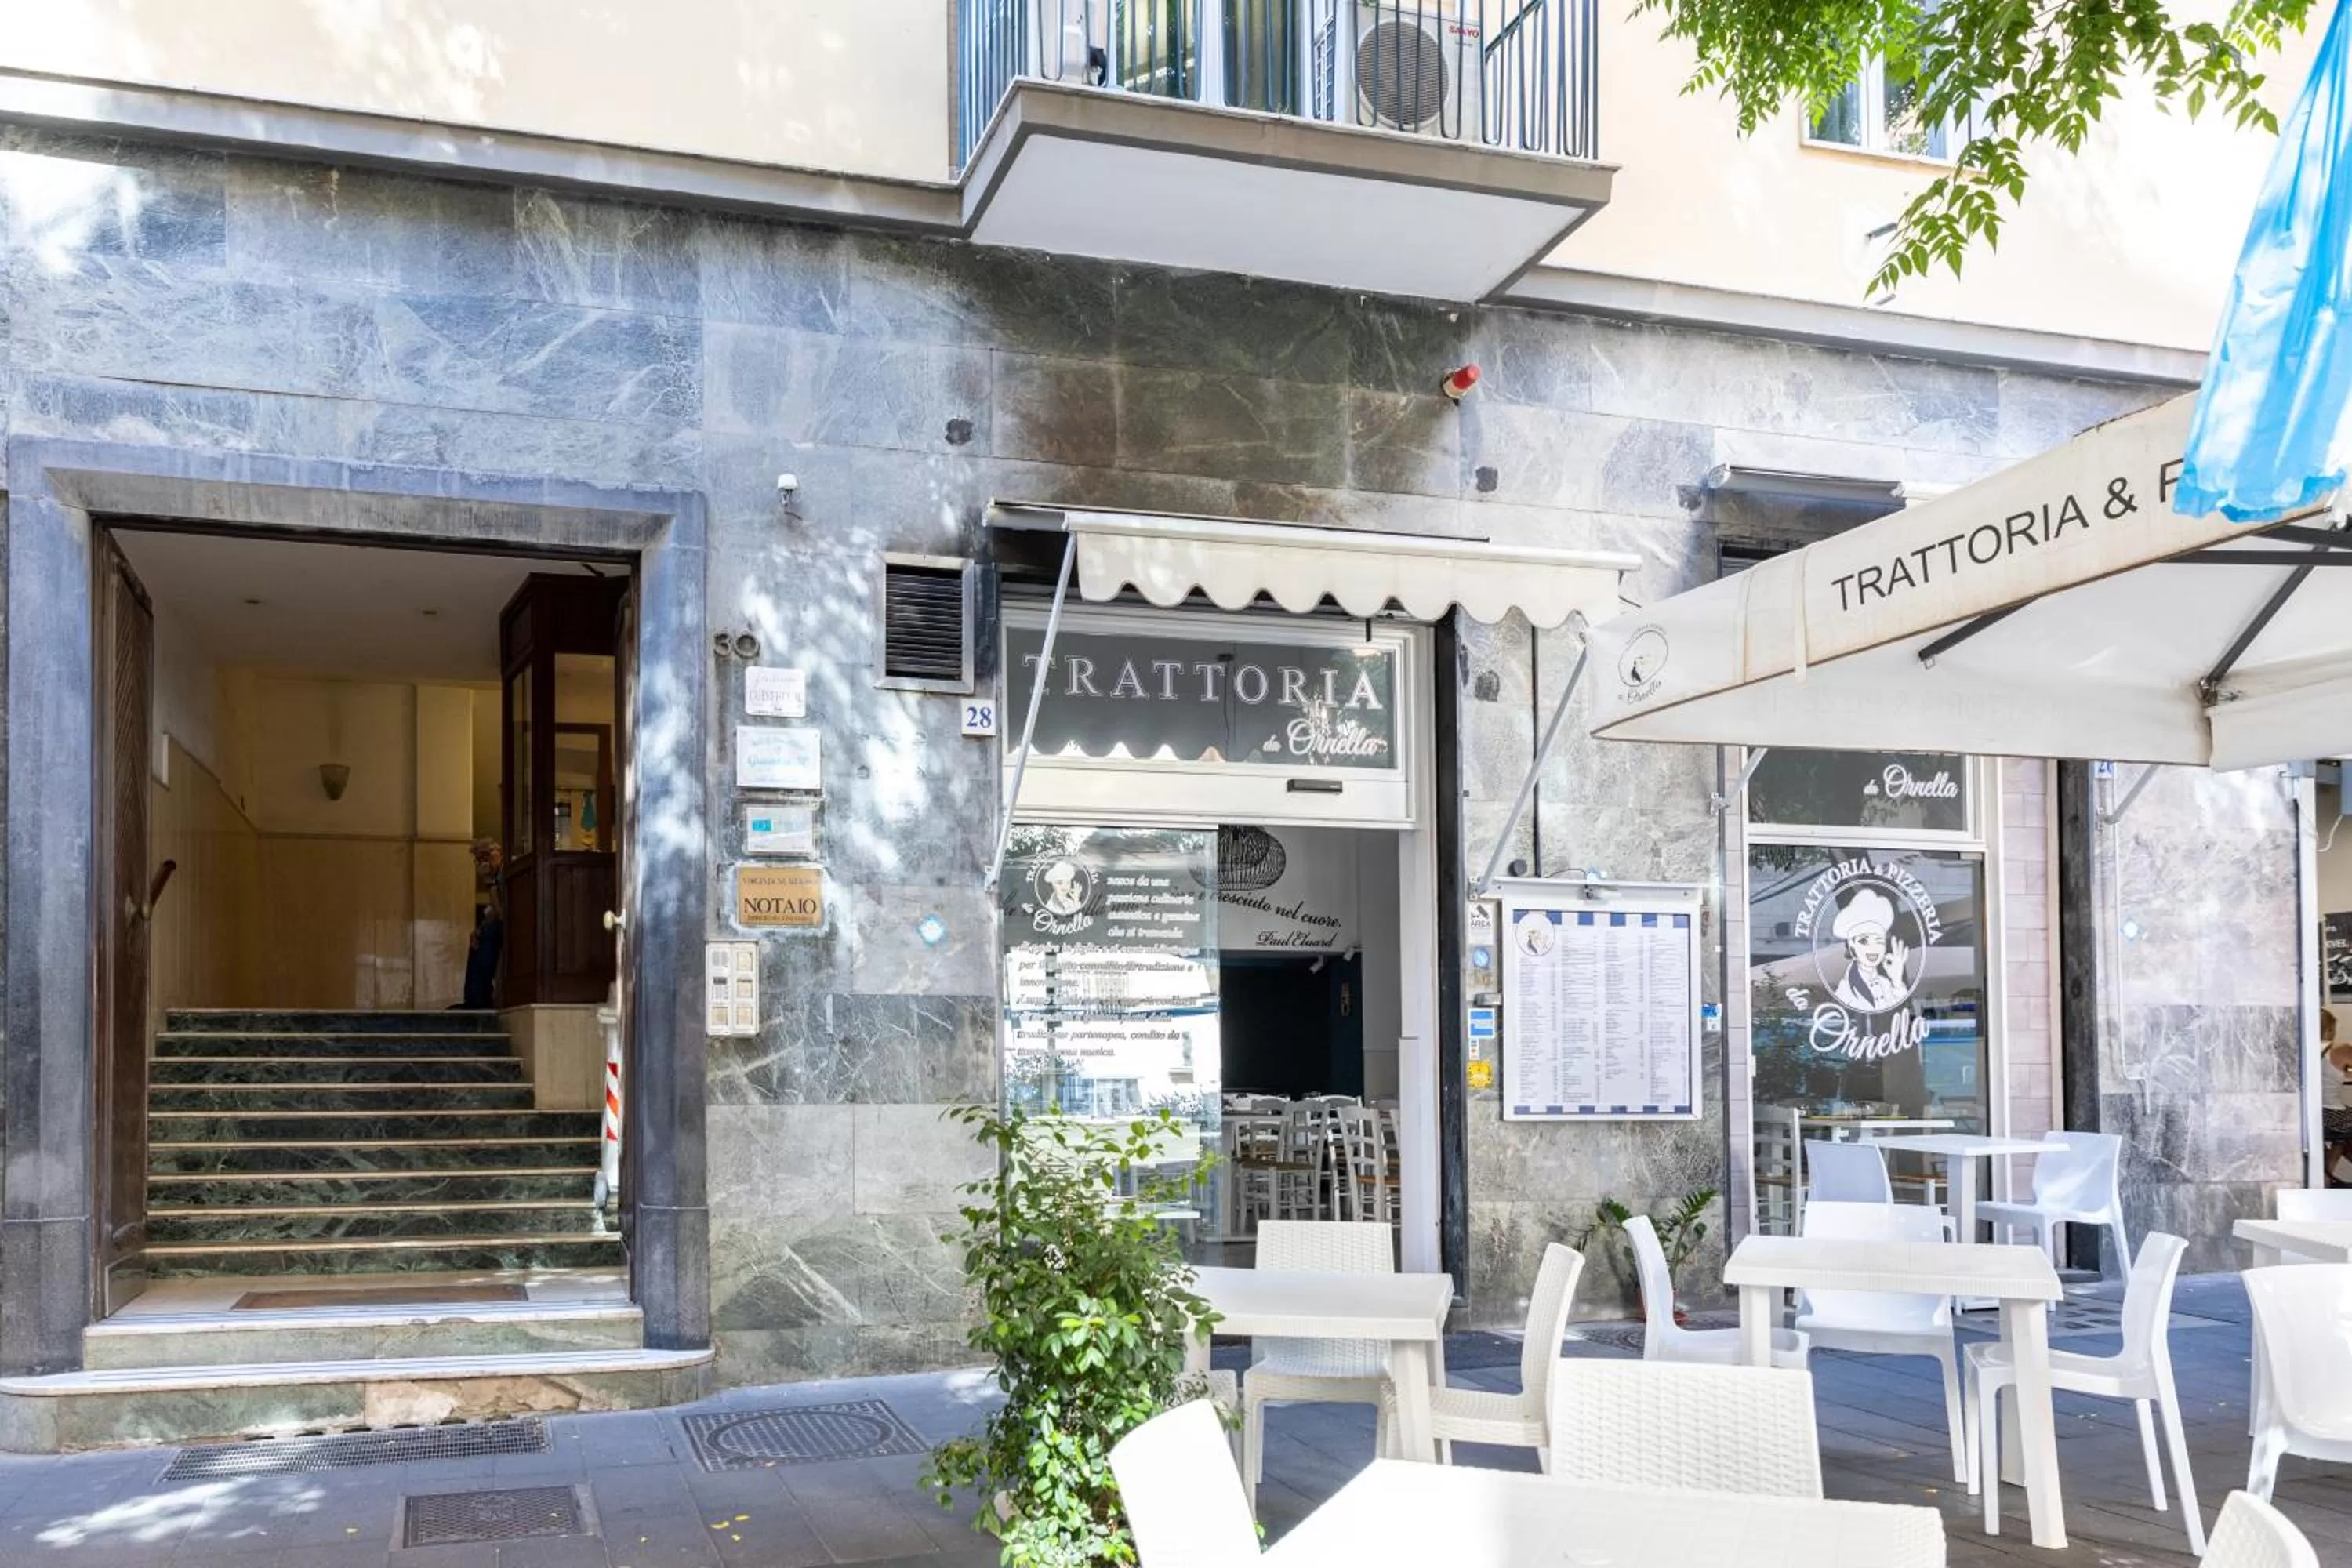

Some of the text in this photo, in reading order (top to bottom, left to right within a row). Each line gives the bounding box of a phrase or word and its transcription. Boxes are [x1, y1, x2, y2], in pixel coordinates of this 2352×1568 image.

[1831, 495, 2089, 611] TRATTORIA
[2103, 477, 2138, 520] &
[713, 632, 760, 659] 30
[1022, 652, 1383, 710] TRATTORIA
[967, 706, 993, 728] 28
[1263, 717, 1388, 757] da Ornella
[1863, 764, 1958, 798] da Ornella
[744, 898, 816, 913] NOTAIO
[1275, 901, 1303, 920] nel
[1301, 913, 1341, 927] cuore.
[1794, 858, 1872, 938] TRATTORIA
[1887, 861, 1944, 945] PIZZERIA
[1032, 909, 1095, 935] Ornella
[1785, 986, 1930, 1062] da Ornella
